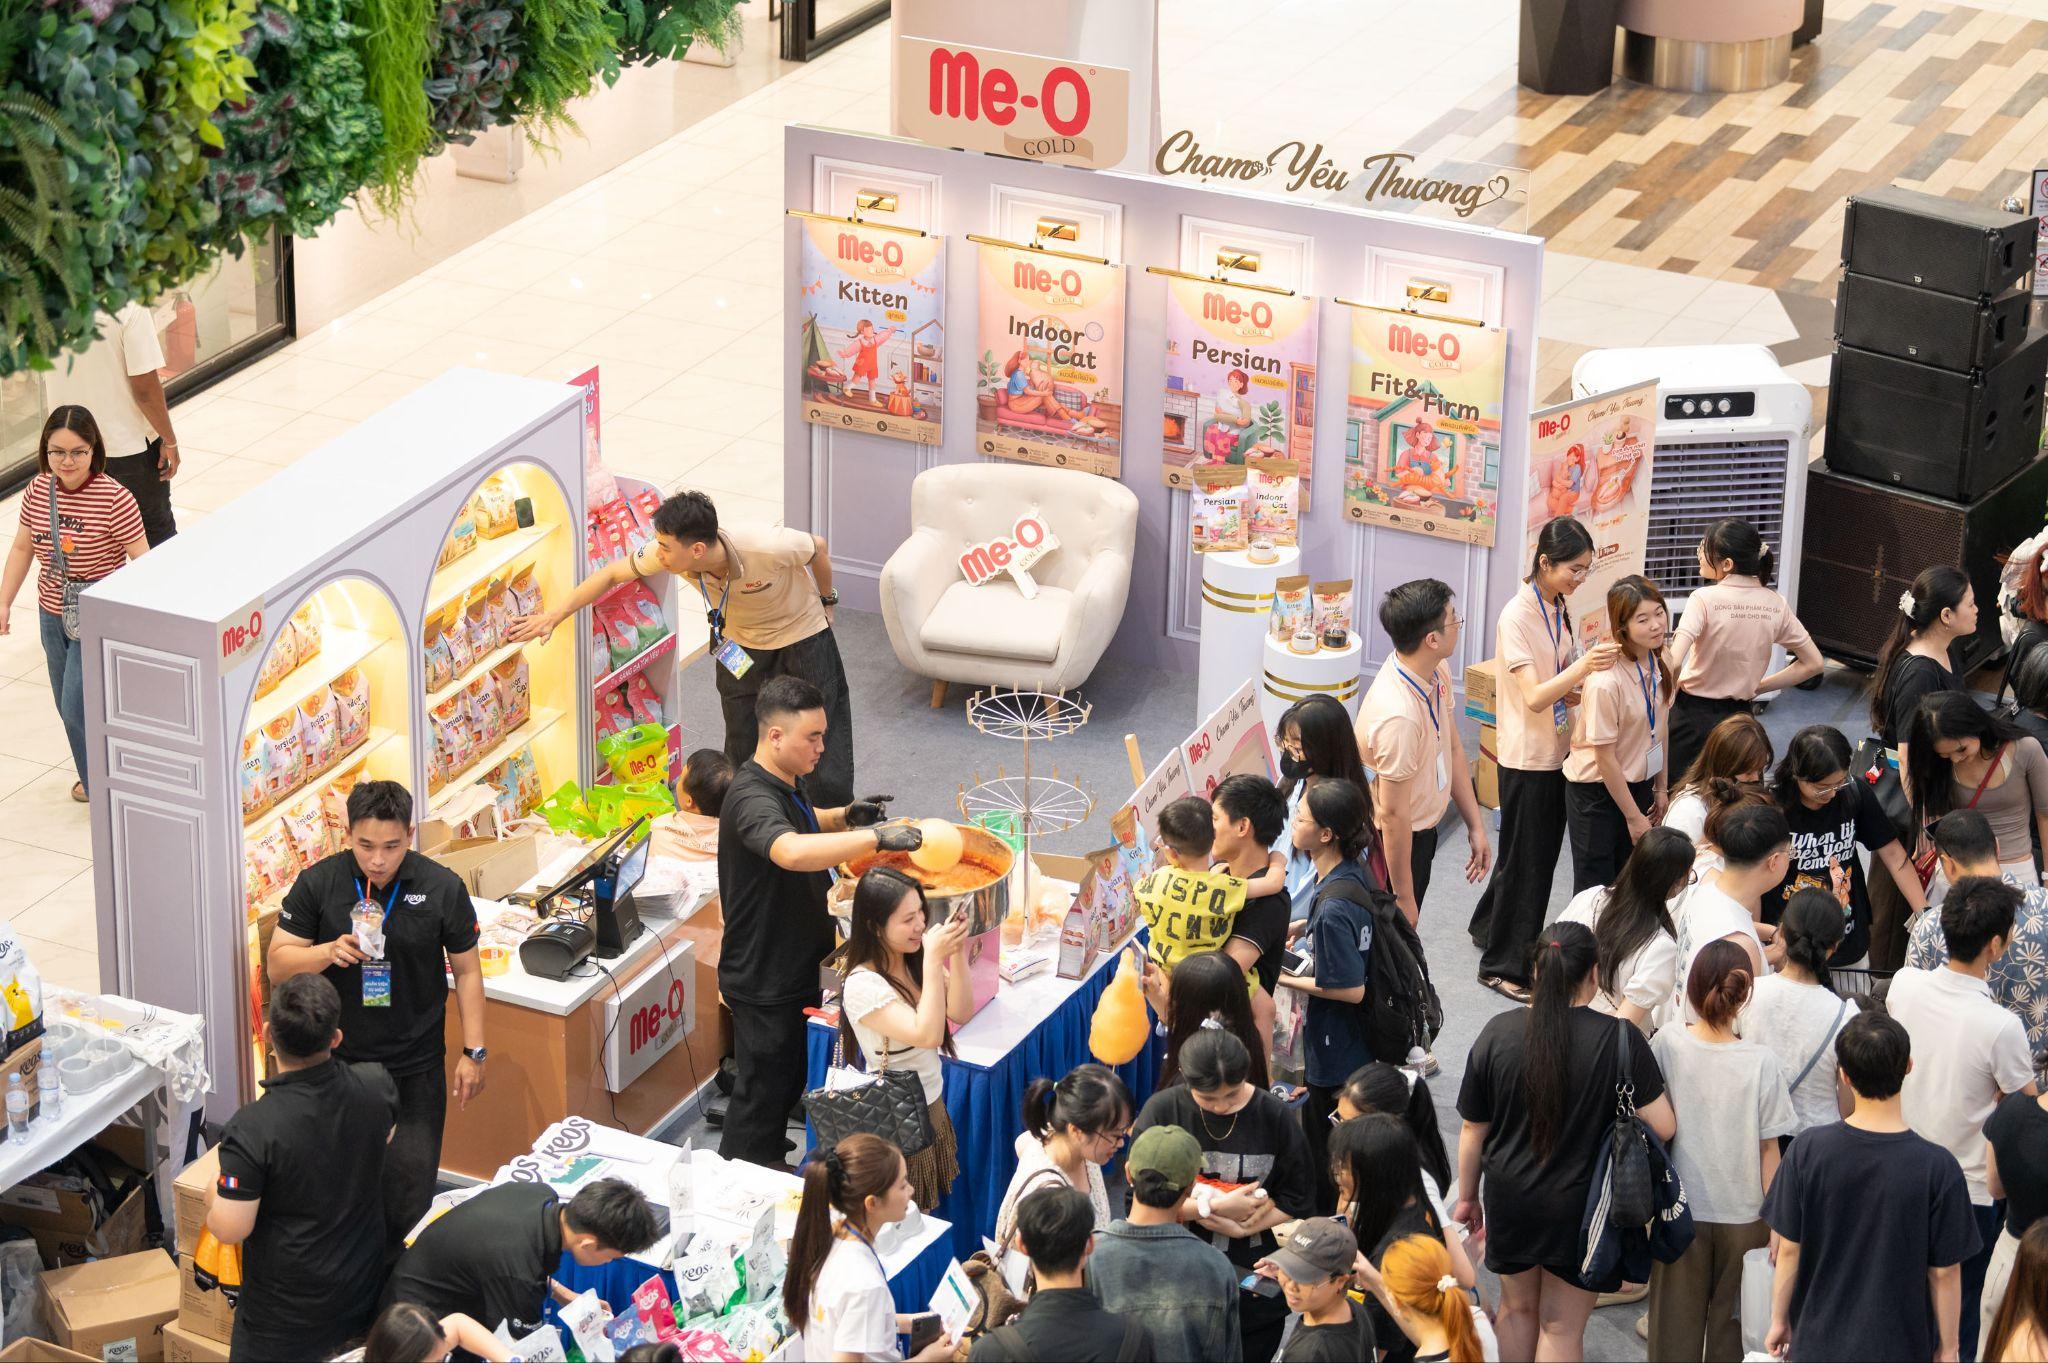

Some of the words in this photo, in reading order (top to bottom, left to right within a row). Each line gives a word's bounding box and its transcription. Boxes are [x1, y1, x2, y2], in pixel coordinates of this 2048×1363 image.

[930, 47, 1091, 137] Me-O
[1023, 138, 1076, 156] GOLD
[1155, 129, 1260, 184] Chạm
[1266, 141, 1349, 192] Yêu
[1363, 153, 1490, 218] Thương
[838, 232, 903, 267] Me-O
[1013, 261, 1082, 297] Me-O
[838, 280, 909, 311] Kitten
[1203, 292, 1273, 329] Me-O
[1009, 315, 1085, 346] Indoor
[1388, 323, 1460, 361] Me-O
[1053, 344, 1097, 370] Cat
[1192, 339, 1281, 375] Persian
[1370, 371, 1423, 400] Fit&
[1423, 392, 1480, 422] Firm
[1538, 414, 1571, 439] Me-O
[1203, 498, 1236, 506] Persian
[1256, 492, 1284, 501] Indoor
[961, 519, 1044, 584] Me-O
[222, 611, 262, 658] Me-O
[629, 754, 657, 776] Me-O
[1788, 831, 1836, 851] When
[629, 979, 685, 1056] Me-O
